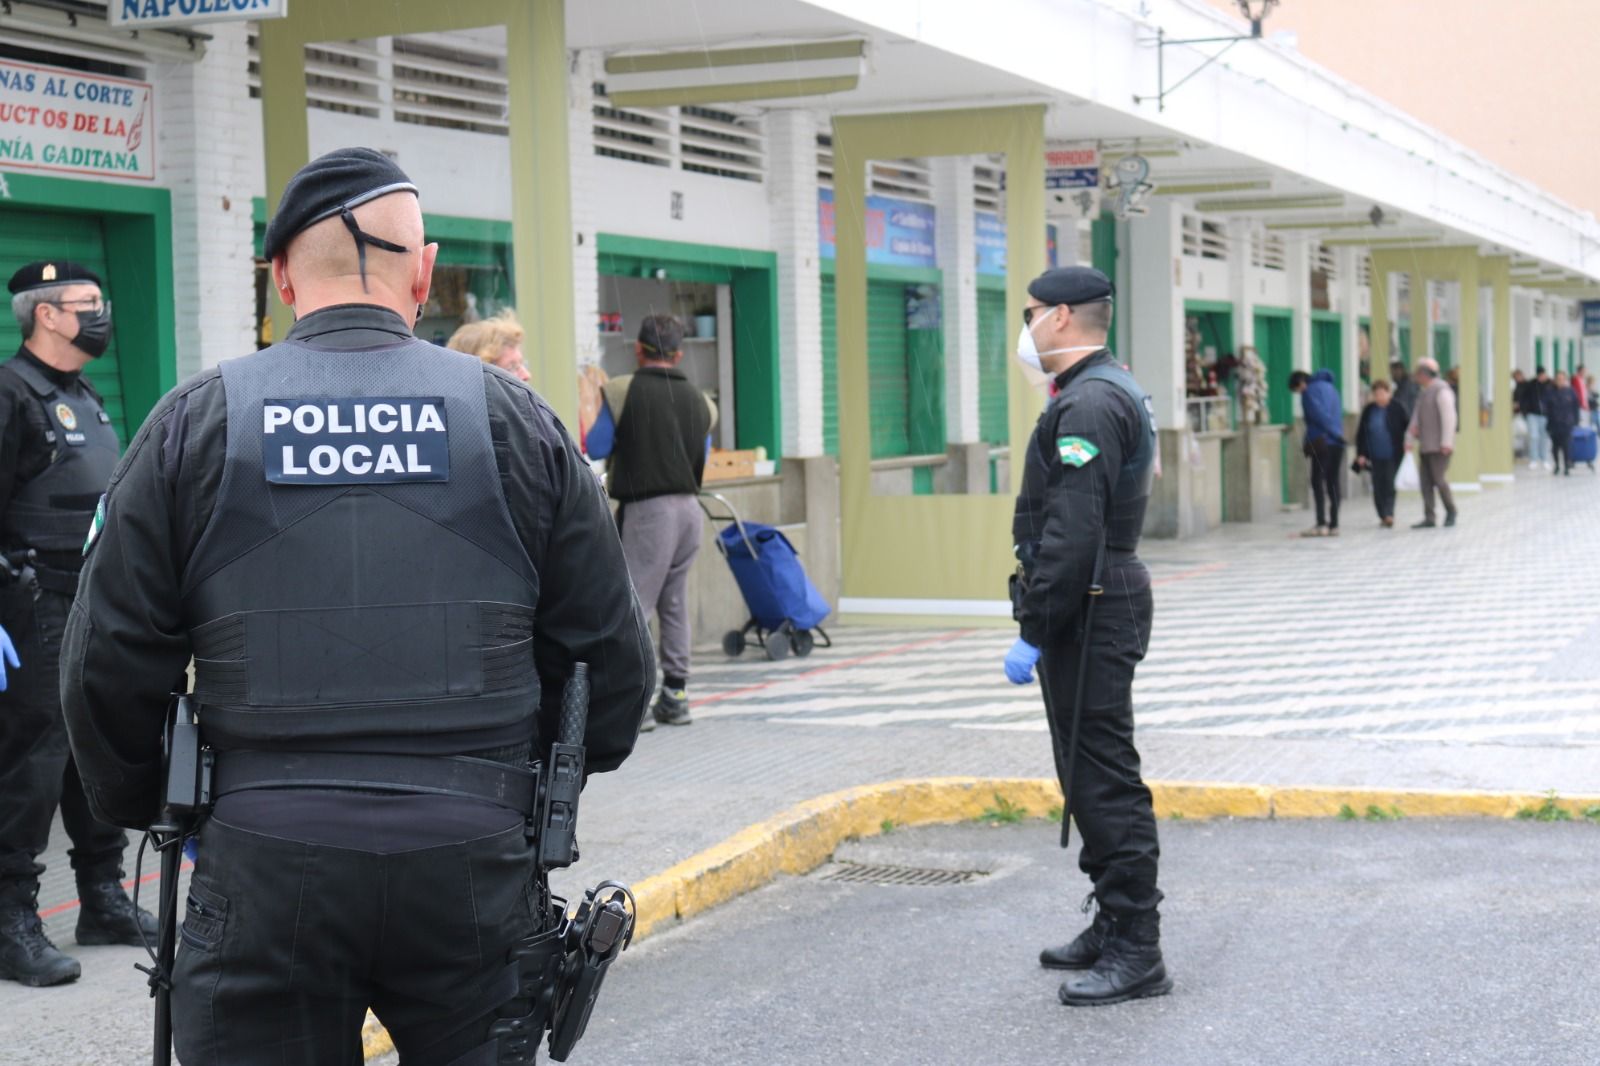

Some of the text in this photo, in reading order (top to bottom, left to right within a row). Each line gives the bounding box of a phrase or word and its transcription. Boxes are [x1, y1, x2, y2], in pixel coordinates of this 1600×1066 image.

[43, 78, 68, 98] AL
[74, 81, 133, 107] CORTE
[73, 112, 98, 134] DE
[103, 117, 126, 137] LA
[43, 144, 139, 171] GADITANA
[264, 404, 446, 434] POLICIA
[282, 444, 431, 475] LOCAL
